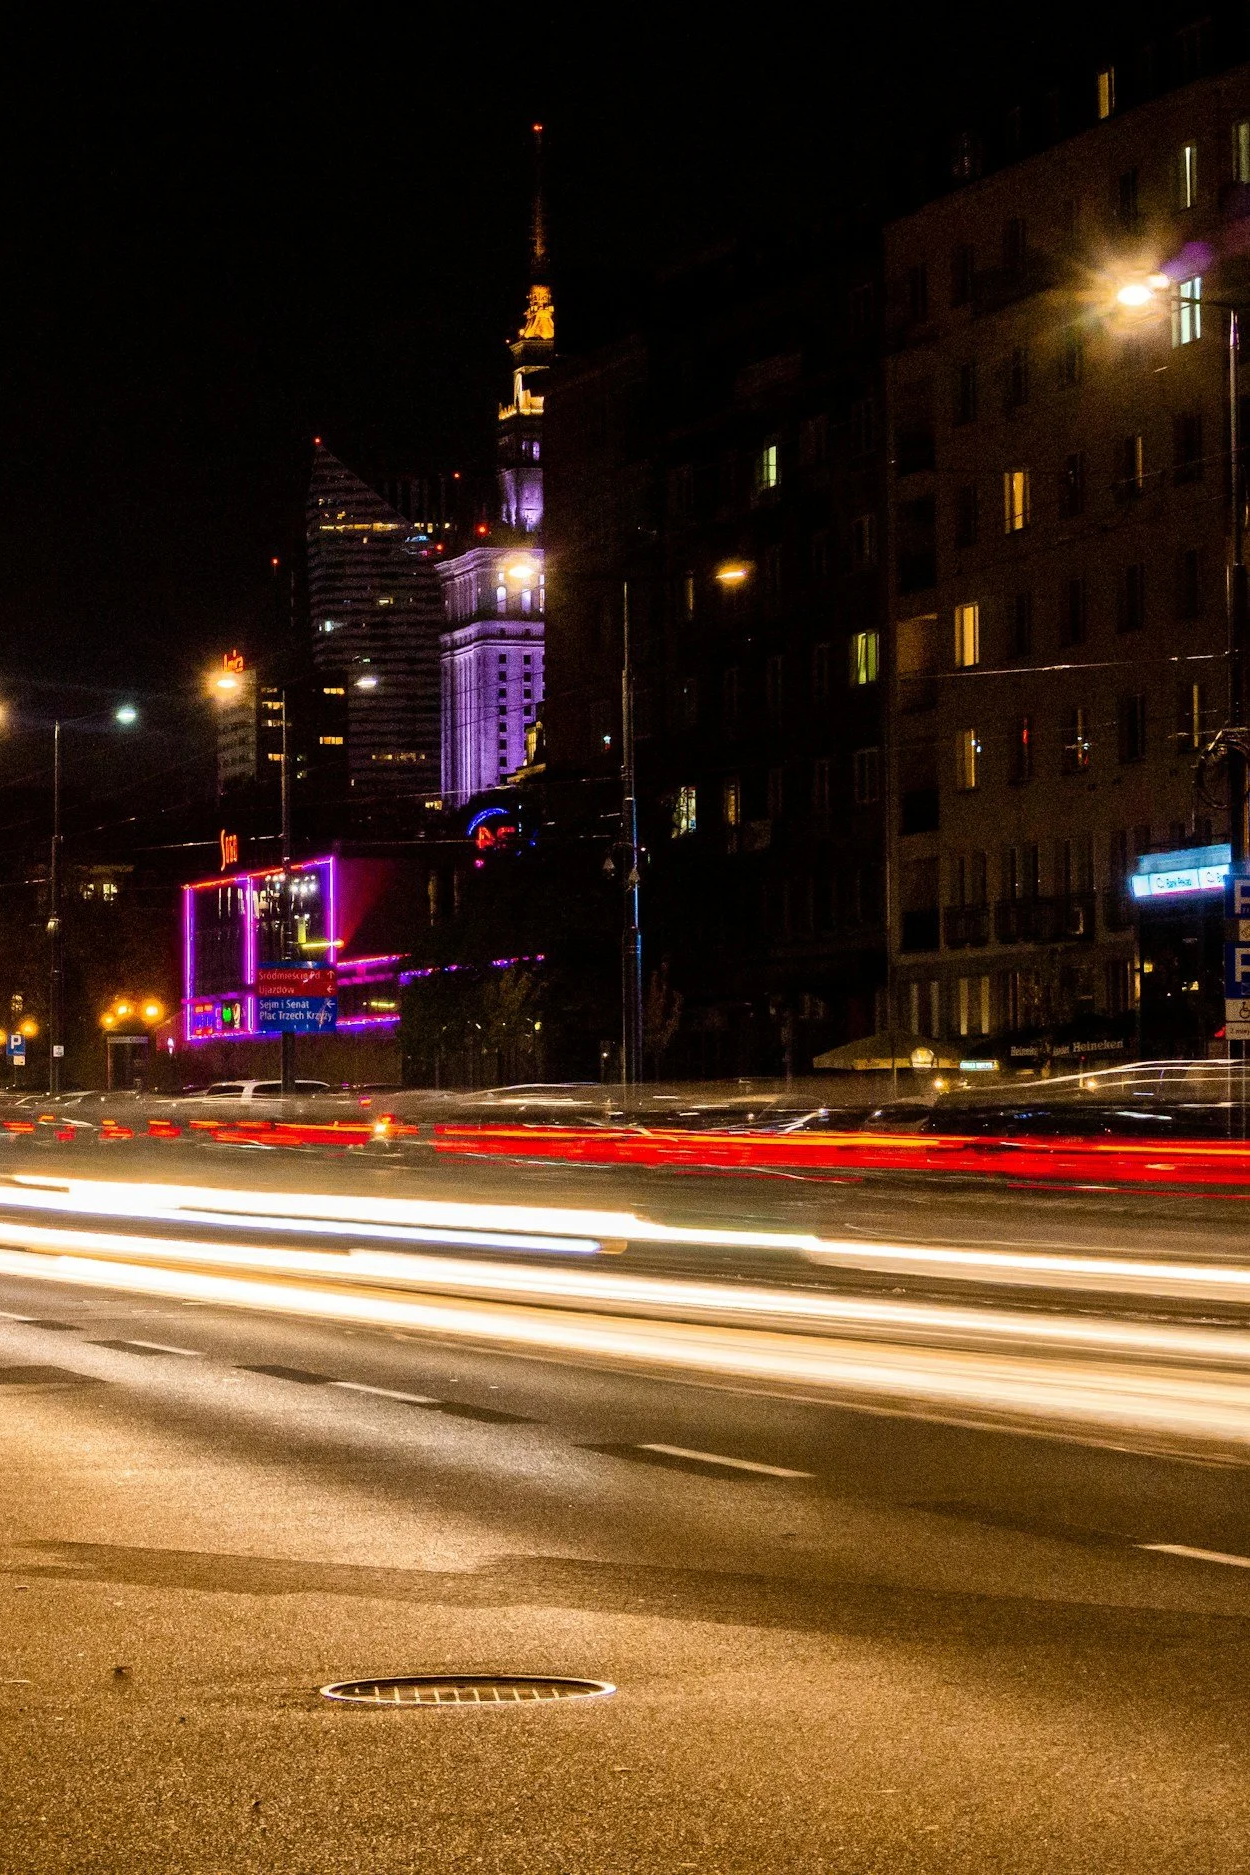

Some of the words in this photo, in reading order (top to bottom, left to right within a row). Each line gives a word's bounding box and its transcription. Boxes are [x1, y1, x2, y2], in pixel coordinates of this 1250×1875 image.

[259, 1000, 279, 1011] Sejm
[286, 1000, 310, 1009] Senat
[259, 1010, 276, 1020] Plac
[278, 1010, 304, 1020] Trzech
[10, 1034, 22, 1050] P
[1072, 1040, 1124, 1053] Heineken
